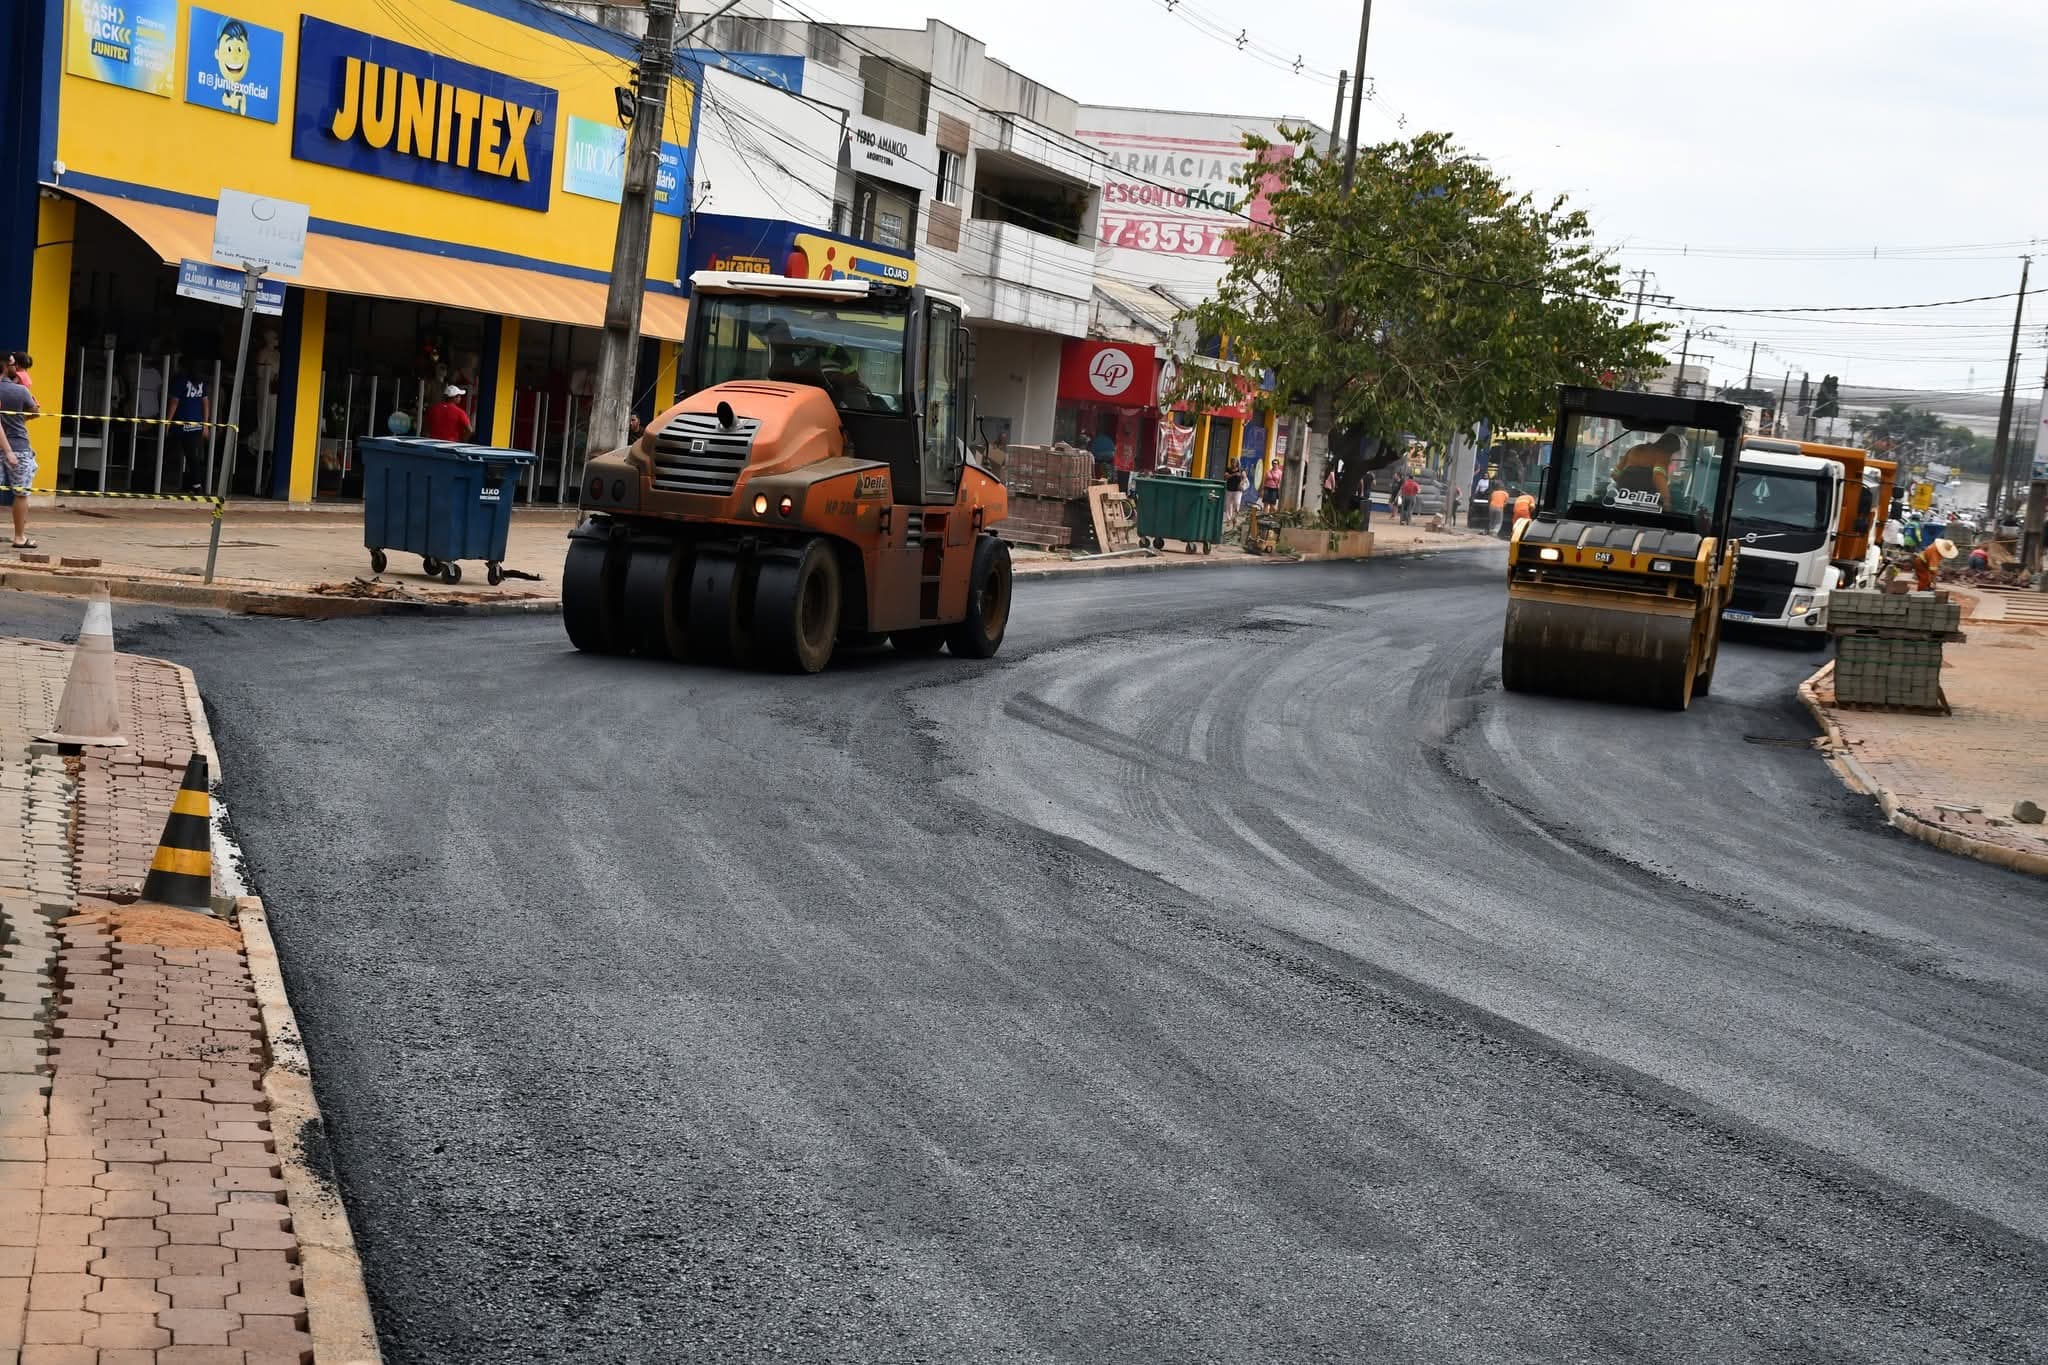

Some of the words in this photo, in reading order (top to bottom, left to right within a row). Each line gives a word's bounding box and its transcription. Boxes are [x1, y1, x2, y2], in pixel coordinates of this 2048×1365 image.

[93, 41, 129, 61] JUNITEX
[213, 73, 269, 100] junitexoficial
[332, 56, 535, 182] JUNITEX
[1097, 215, 1225, 255] 7-3557
[883, 265, 909, 281] LOJAS
[481, 487, 500, 496] LIXO
[1618, 488, 1662, 505] Dellai
[1595, 552, 1611, 563] CAT
